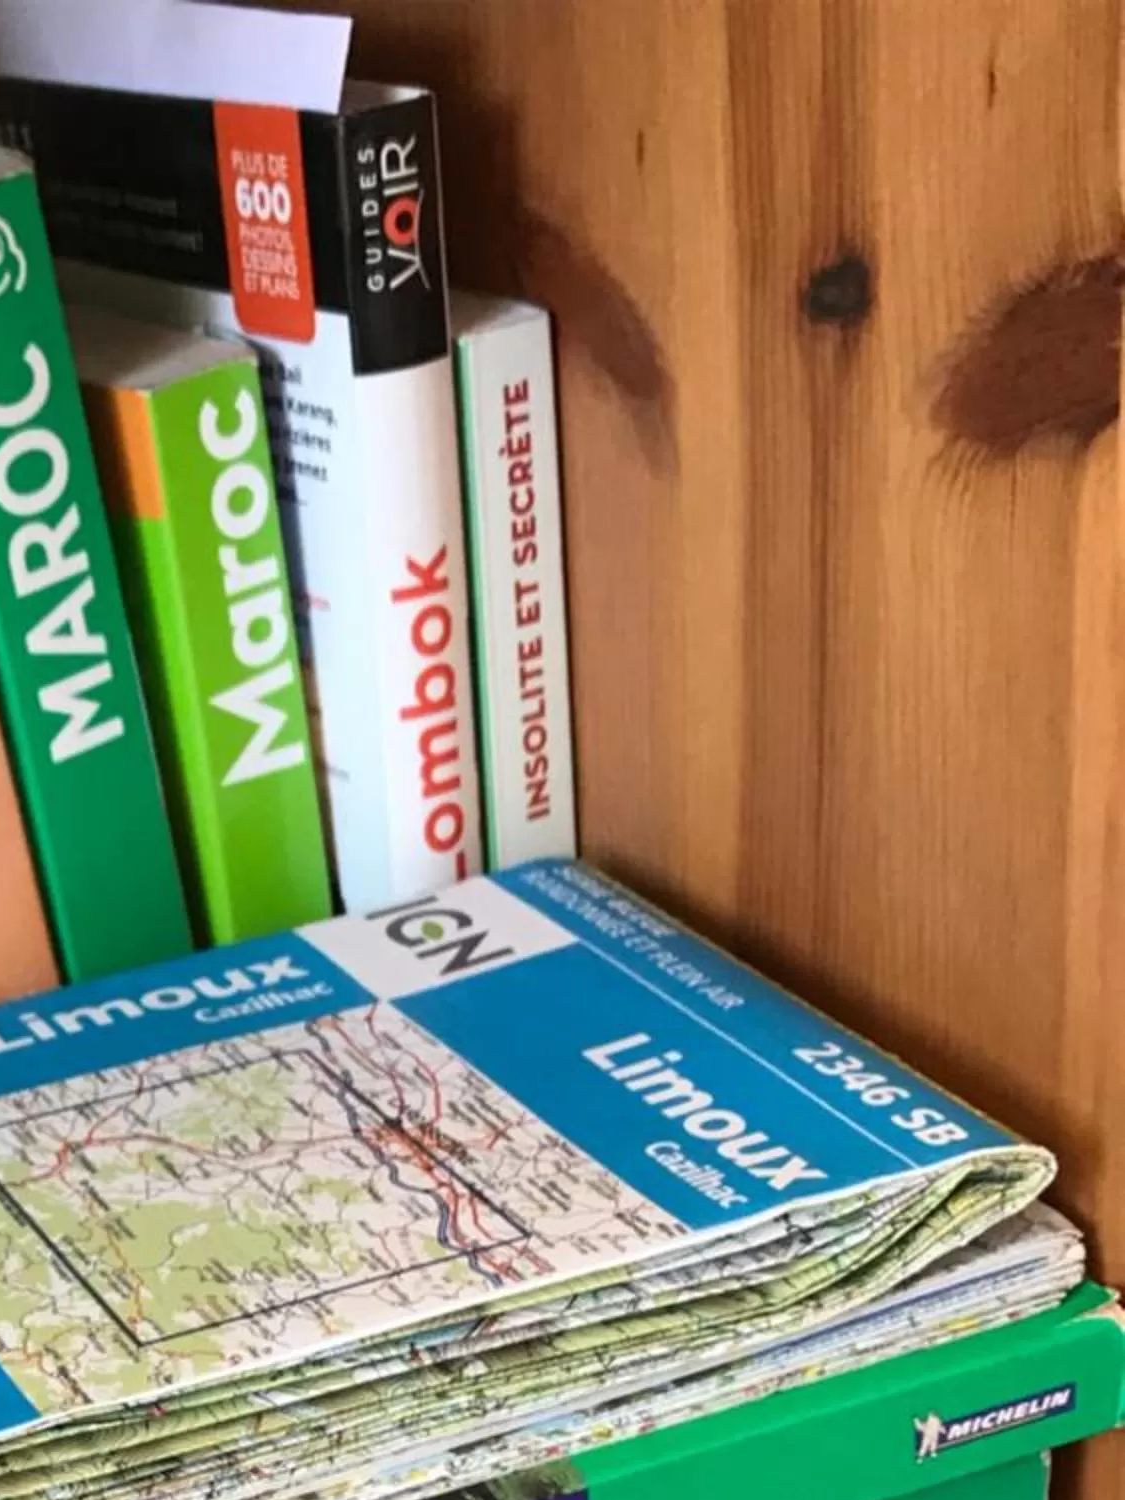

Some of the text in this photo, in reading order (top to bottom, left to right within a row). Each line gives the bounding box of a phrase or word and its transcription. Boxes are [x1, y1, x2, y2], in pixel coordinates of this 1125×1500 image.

[235, 176, 292, 225] 600
[357, 147, 385, 292] GUIDES
[380, 133, 422, 290] VOIR
[198, 387, 306, 787] Maroc
[498, 379, 551, 821] INSOLITE ET SECRÈTE
[366, 896, 514, 976] IGN
[582, 1032, 828, 1191] Limoux
[792, 1041, 969, 1148] 2346 SB
[644, 1140, 751, 1210] Cazilhac
[946, 1388, 1072, 1442] MICHELIN
